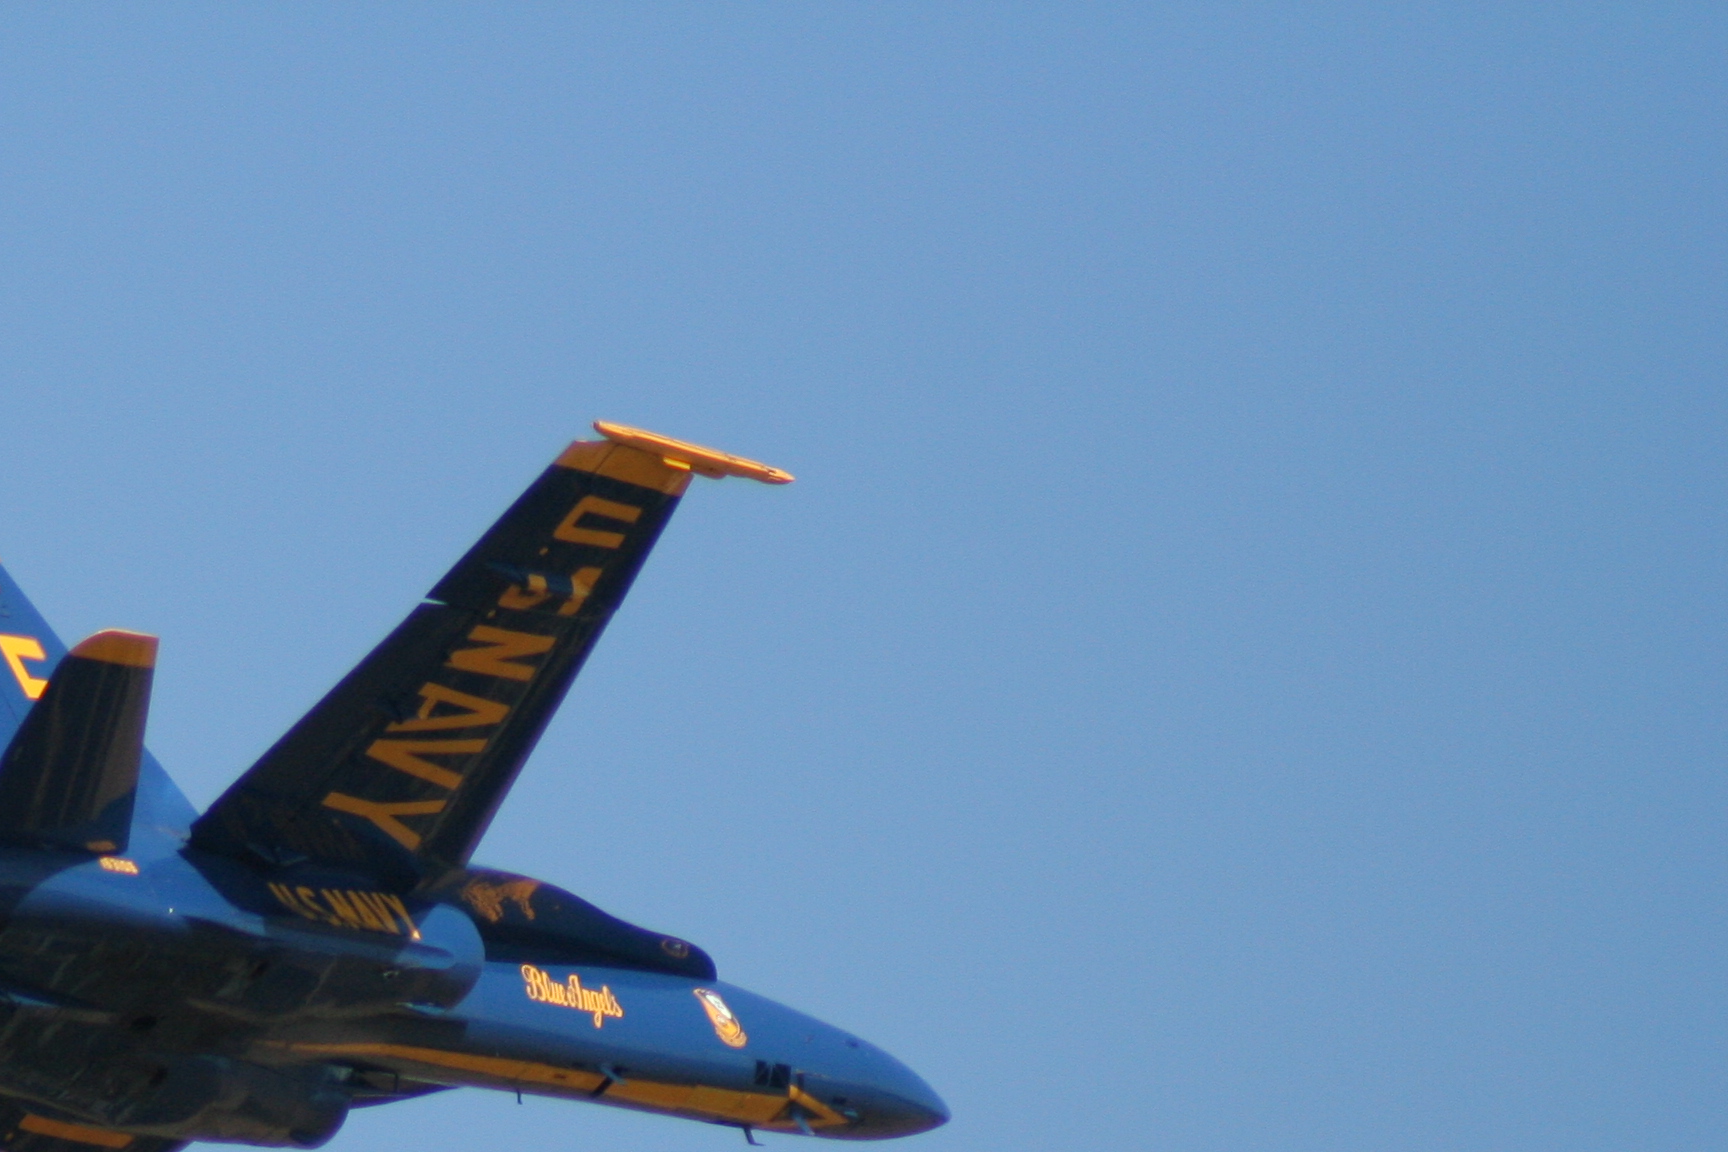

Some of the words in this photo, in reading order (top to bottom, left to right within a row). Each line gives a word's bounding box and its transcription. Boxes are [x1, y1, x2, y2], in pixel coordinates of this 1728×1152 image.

[321, 625, 557, 852] NAVY
[520, 964, 569, 1006] Blue
[566, 974, 624, 1029] Angels
